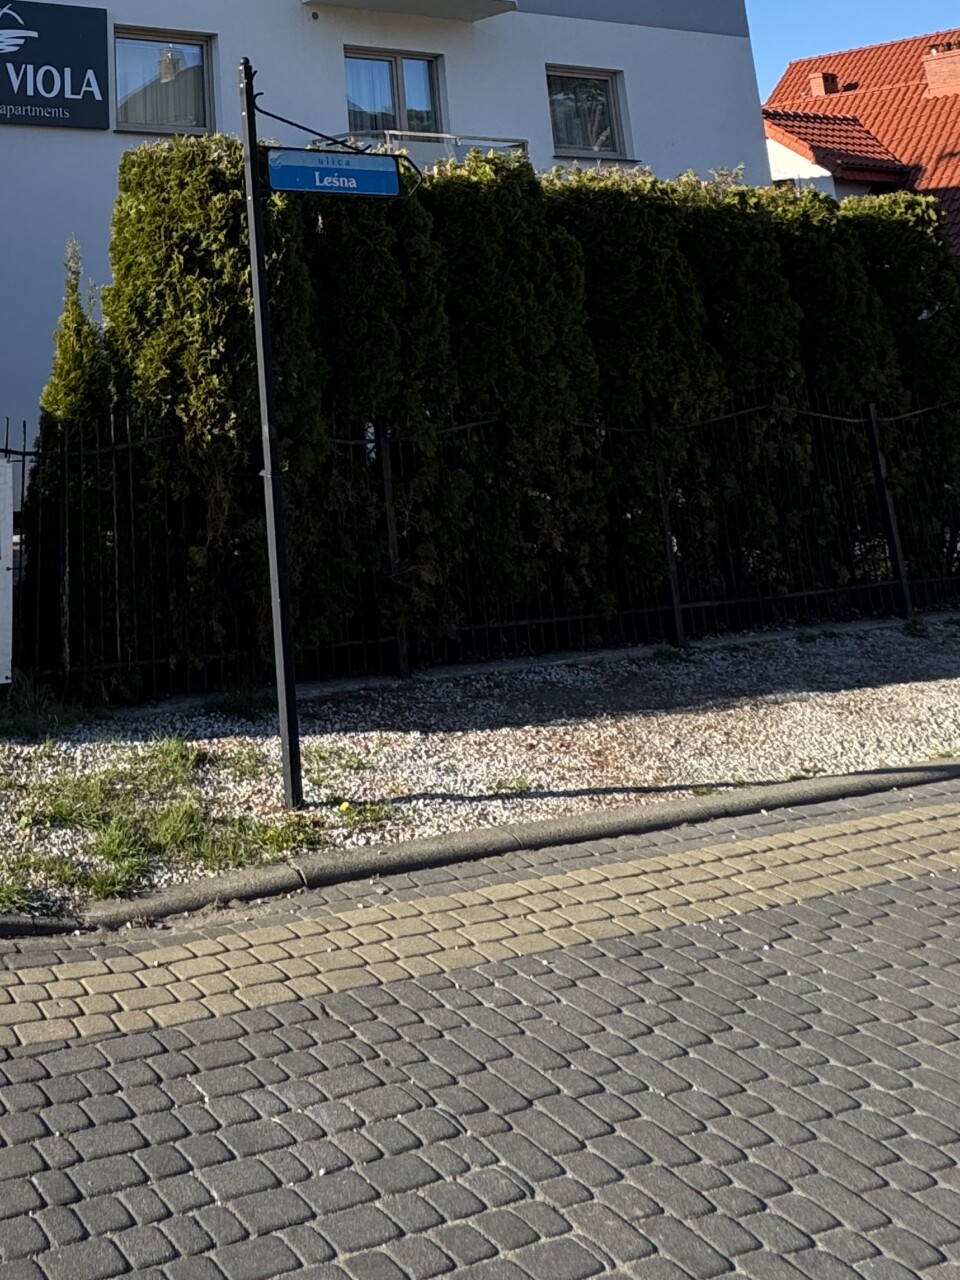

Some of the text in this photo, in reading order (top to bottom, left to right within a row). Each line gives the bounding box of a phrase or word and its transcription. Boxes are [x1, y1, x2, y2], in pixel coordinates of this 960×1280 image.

[6, 62, 103, 101] VIOLA
[0, 103, 70, 118] apartments
[318, 156, 351, 167] ulica
[314, 171, 357, 188] Leśna
